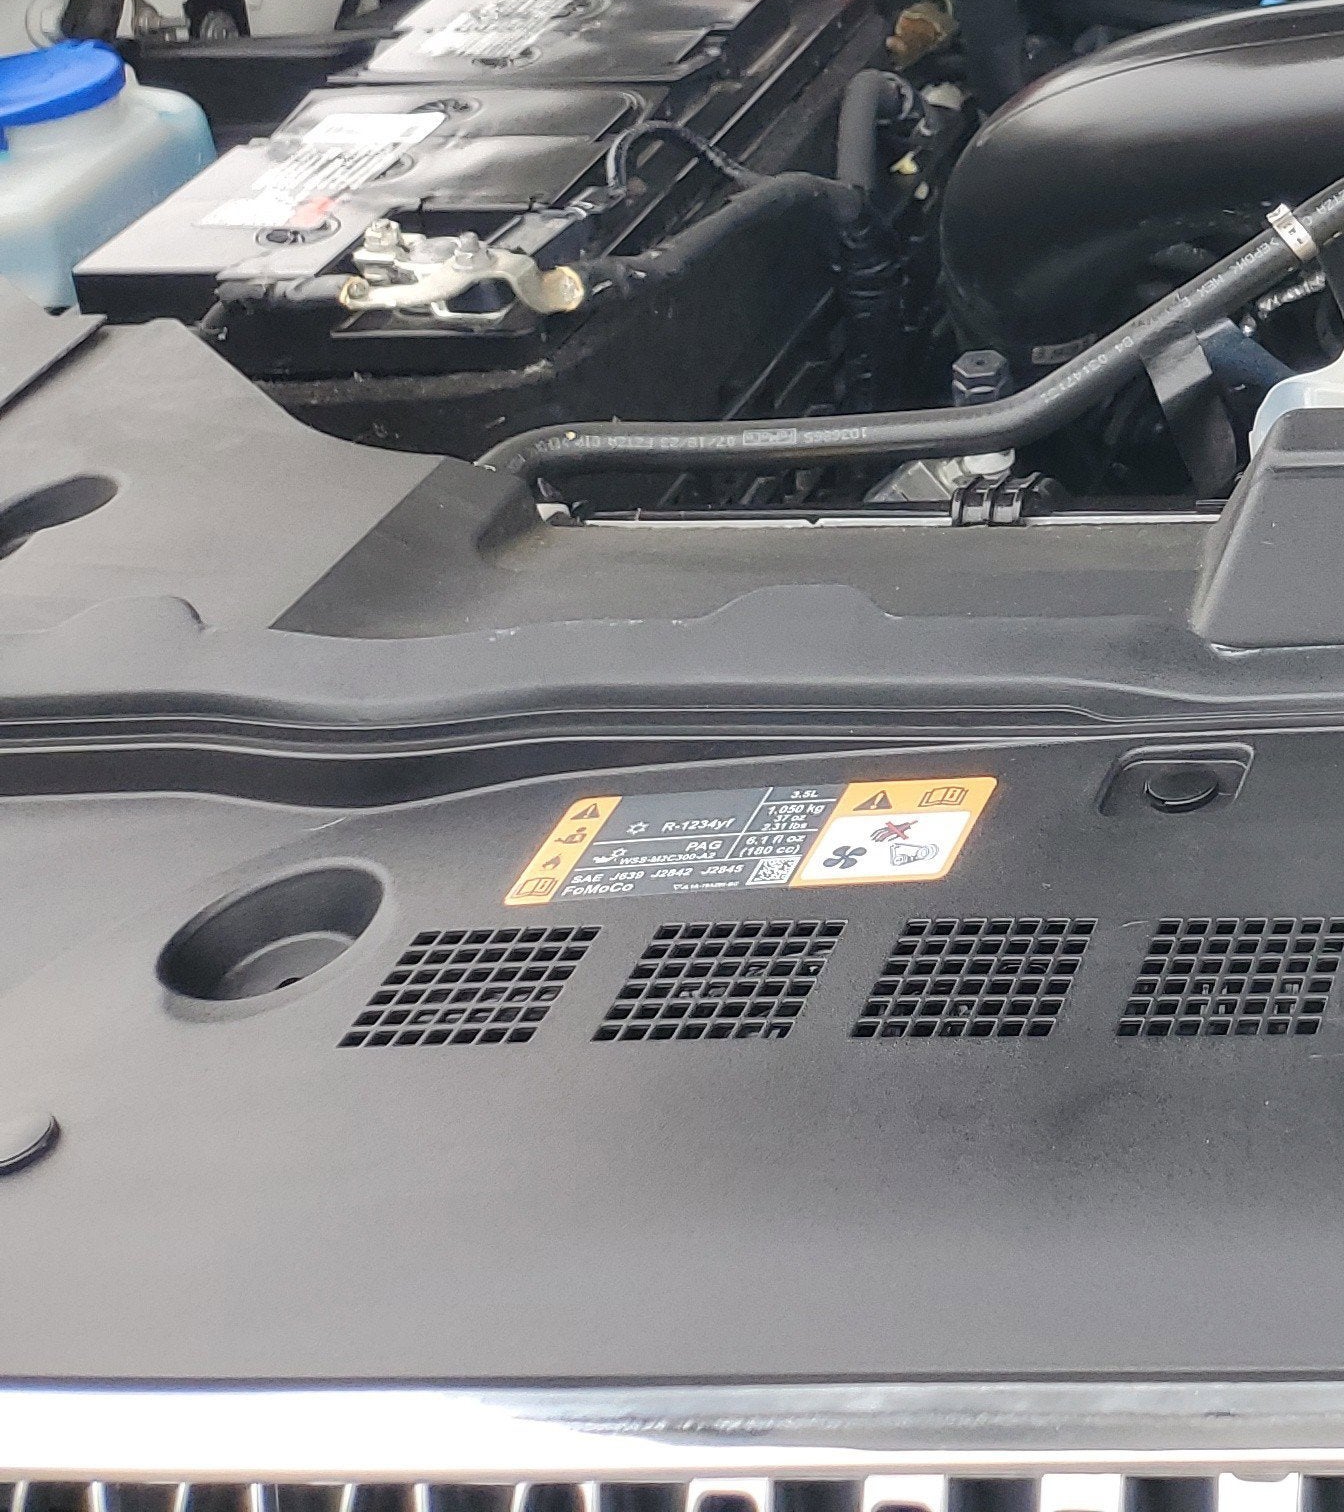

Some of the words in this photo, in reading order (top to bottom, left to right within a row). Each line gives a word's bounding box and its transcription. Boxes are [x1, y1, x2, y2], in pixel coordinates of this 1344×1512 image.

[790, 790, 819, 799] 3.5L
[768, 805, 804, 816] 1.050
[806, 804, 825, 814] kg
[661, 818, 736, 832] R-1234yf
[773, 815, 790, 823] 37
[761, 823, 787, 831] 2.31
[685, 840, 723, 852] PAG
[745, 836, 770, 846] 6.1
[772, 835, 784, 844] fl
[786, 835, 806, 843] oz
[739, 846, 774, 858] (180
[776, 844, 801, 855] cc)
[571, 873, 604, 884] SAE
[701, 864, 745, 875] J2845
[561, 883, 634, 896] FoMoCo
